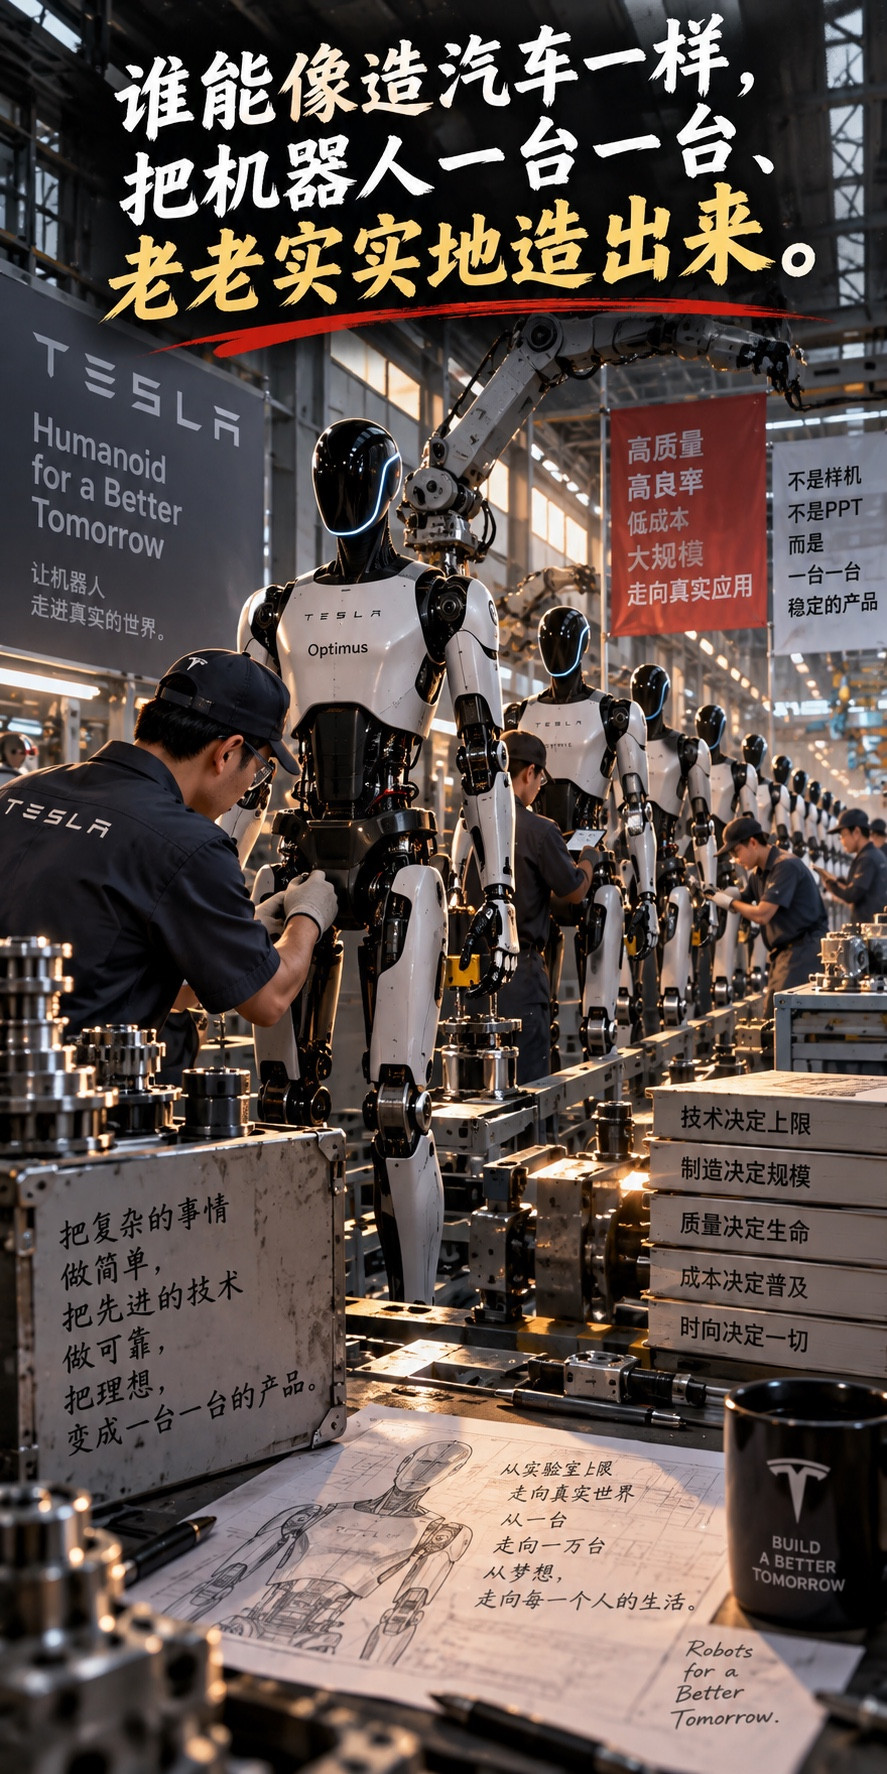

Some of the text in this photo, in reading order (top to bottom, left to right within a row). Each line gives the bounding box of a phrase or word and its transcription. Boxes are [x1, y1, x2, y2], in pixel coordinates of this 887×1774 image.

[33, 331, 241, 447] TESLA
[33, 411, 166, 484] Humanoid
[628, 429, 704, 464] 高质量
[32, 453, 183, 526] for a Better
[628, 467, 704, 502] 高良率
[788, 465, 862, 492] 不是样机
[628, 506, 689, 536] 低成本
[788, 498, 864, 524] 不是PPT
[31, 496, 165, 559] Tomorrow
[788, 532, 824, 555] 而是
[628, 540, 704, 572] 大规模
[31, 561, 105, 599] 让机器人
[788, 561, 861, 585] 一台一台
[628, 574, 753, 606] 走向真实应用
[788, 592, 878, 617] 稳定的产品
[31, 594, 164, 641] 走进真实的世界。
[304, 610, 381, 621] TESLA
[308, 642, 368, 659] Optimus
[5, 798, 112, 838] TESLA
[681, 1105, 811, 1136] 技术决定上限
[681, 1156, 811, 1188] 制造决定规模
[59, 1193, 230, 1250] 把复杂的事情
[680, 1211, 810, 1244] 质量决定生命
[61, 1246, 161, 1291] 做简单，
[680, 1266, 808, 1299] 成本决定普及
[62, 1270, 243, 1332] 把先进的技术
[62, 1326, 164, 1374] 做可靠，
[681, 1316, 808, 1353] 时向决定一切
[63, 1369, 164, 1415] 把理想，
[68, 1370, 315, 1456] 变成一台一台的产品。
[507, 1484, 635, 1503] 走向真实世界
[500, 1511, 568, 1528] 从一台
[493, 1536, 606, 1555] 走向一万台
[772, 1535, 821, 1554] BUILD
[752, 1566, 846, 1592] TOMORROW
[759, 1552, 836, 1574] A BETTER
[474, 1589, 697, 1612] 走向每一个人的生活。
[685, 1639, 753, 1658] Robots
[683, 1662, 739, 1682] for a
[675, 1684, 744, 1703] Better
[670, 1708, 779, 1730] Tomorrow.
